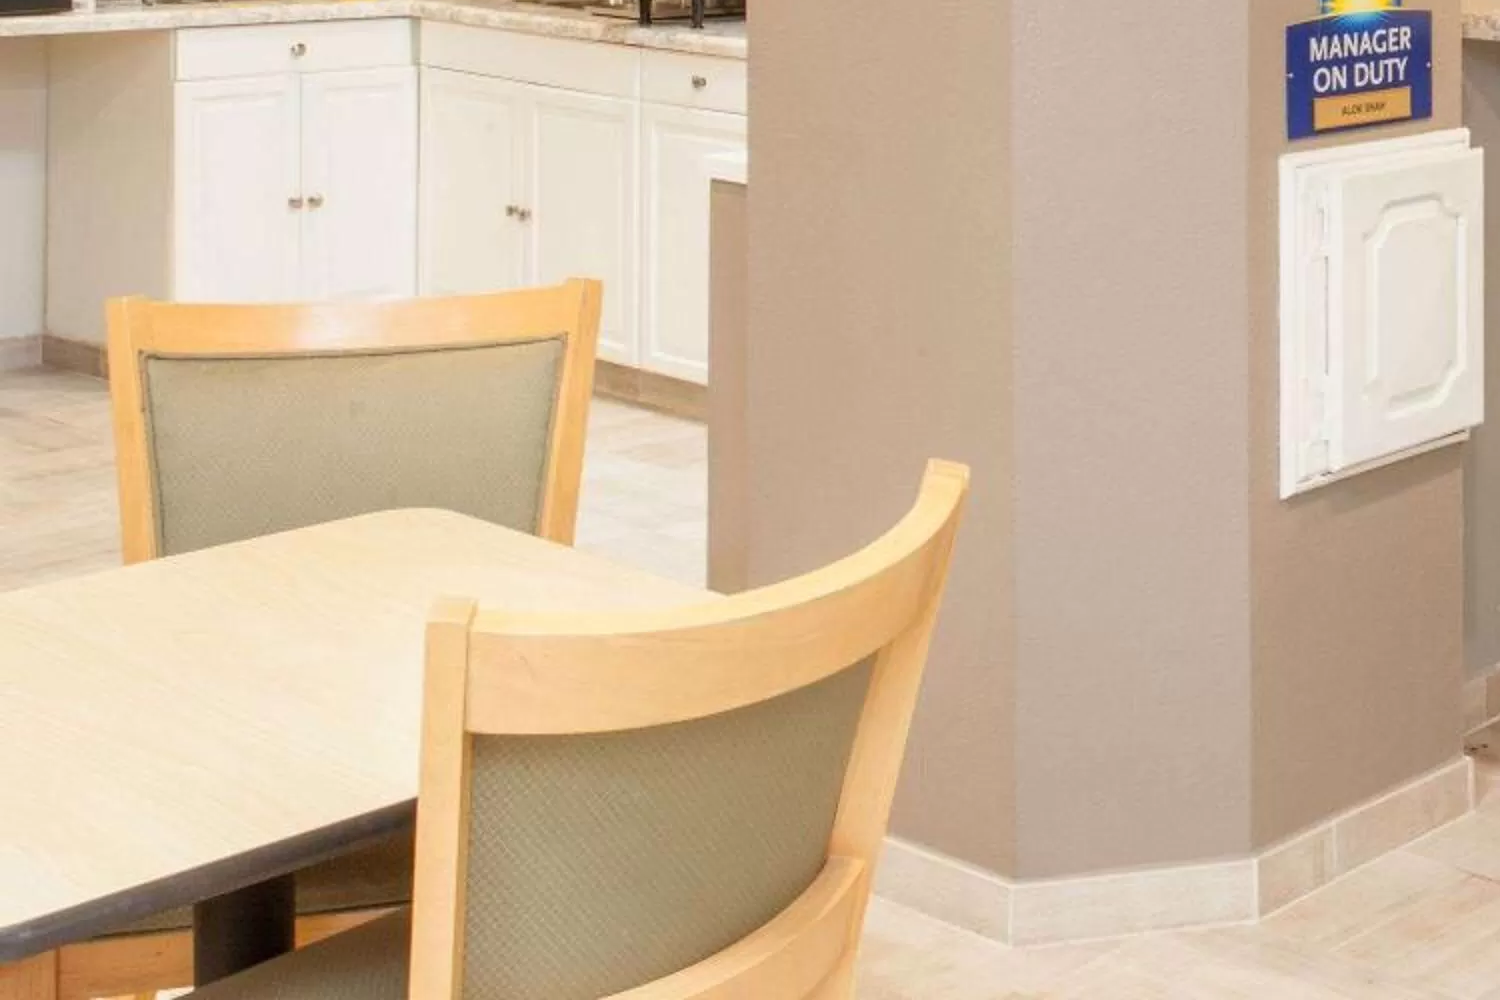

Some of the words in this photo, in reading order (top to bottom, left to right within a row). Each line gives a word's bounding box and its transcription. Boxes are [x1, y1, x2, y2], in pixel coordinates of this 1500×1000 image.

[1309, 26, 1412, 62] MANAGER
[1313, 64, 1347, 93] ON
[1354, 56, 1409, 88] DUTY
